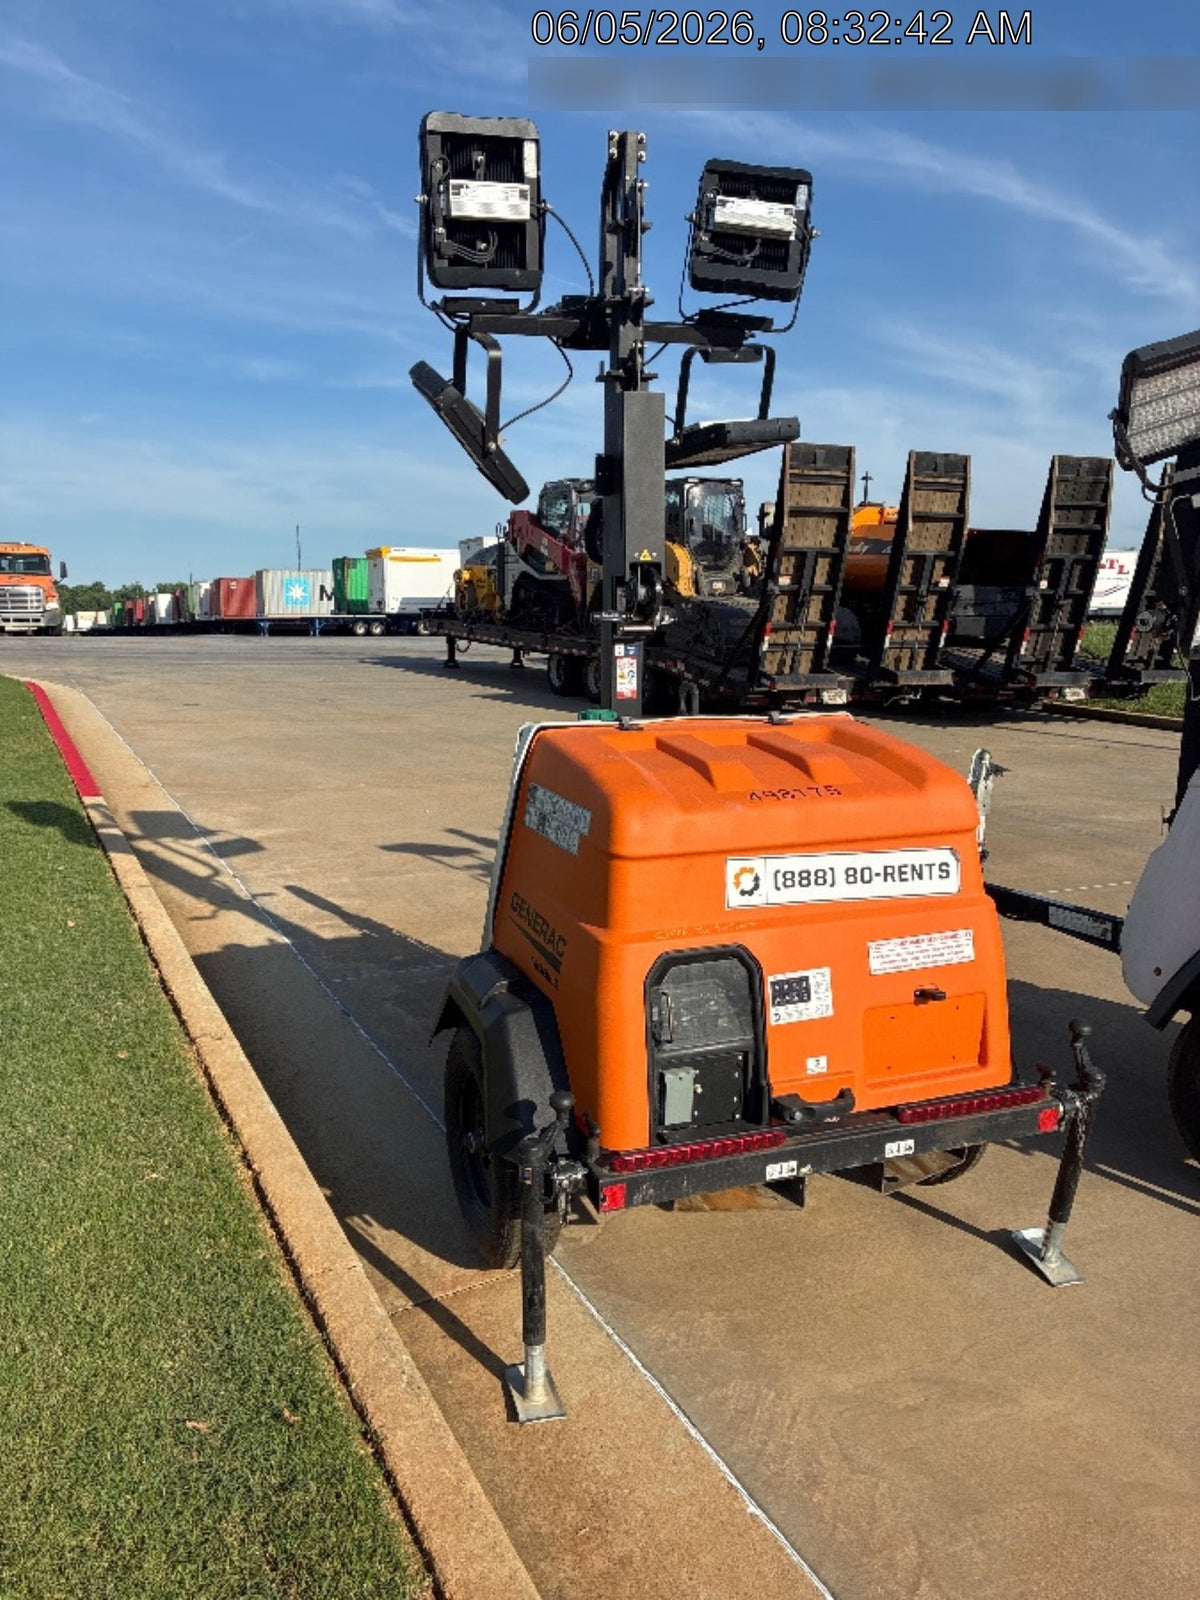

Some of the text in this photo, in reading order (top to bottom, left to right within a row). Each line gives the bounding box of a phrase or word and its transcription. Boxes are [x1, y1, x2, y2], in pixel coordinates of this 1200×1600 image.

[774, 861, 951, 891] (888) 80-RENTS
[511, 891, 567, 958] GENERAC
